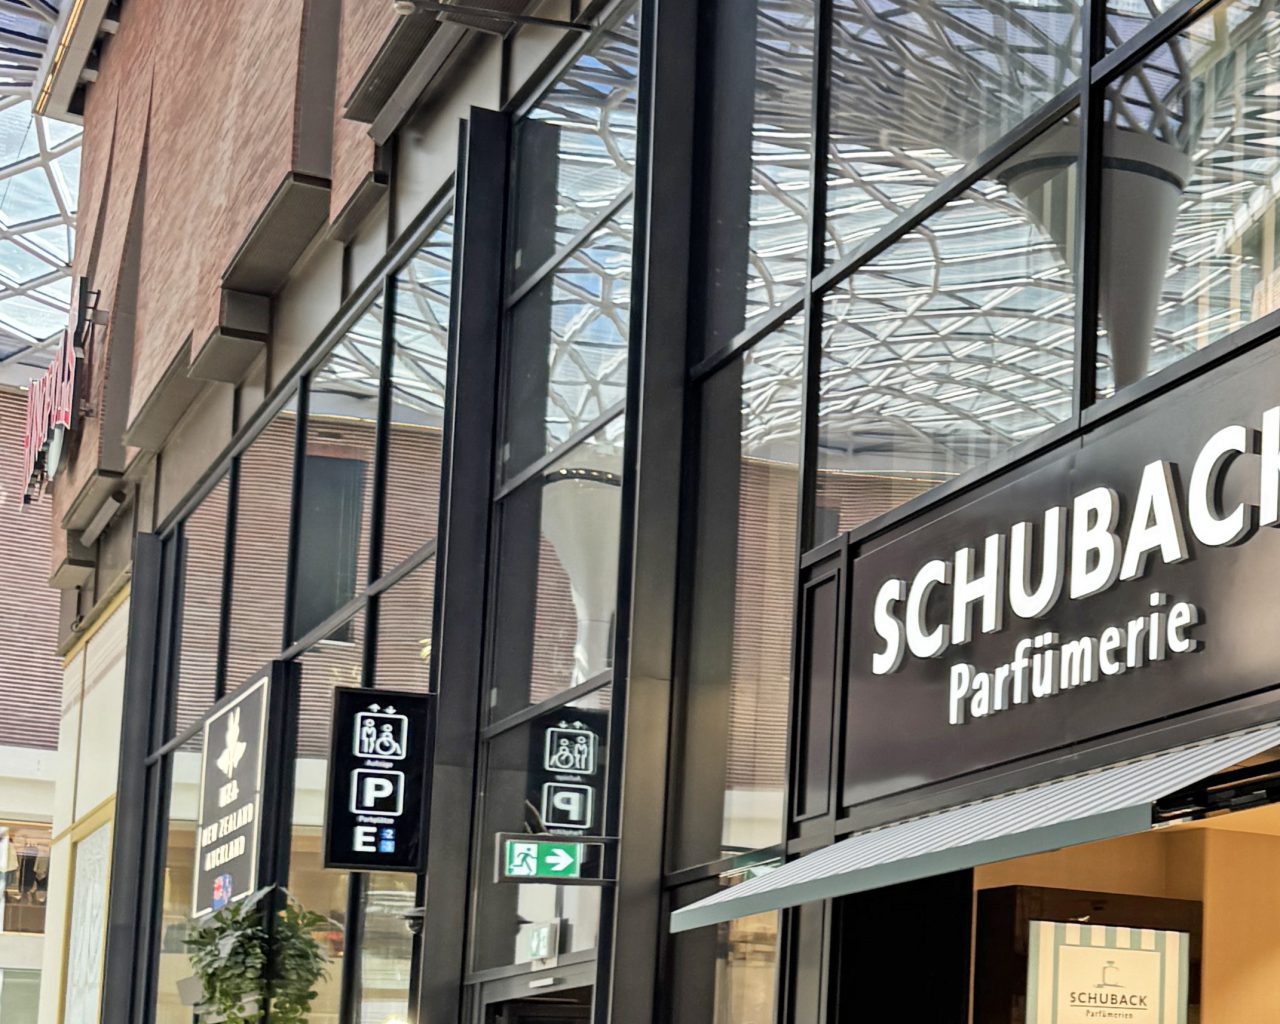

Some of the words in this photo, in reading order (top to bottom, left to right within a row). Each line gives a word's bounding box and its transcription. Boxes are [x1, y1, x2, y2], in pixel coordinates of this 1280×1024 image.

[949, 591, 1200, 725] Parfümerie
[363, 777, 394, 808] P
[353, 825, 378, 853] E
[1069, 991, 1148, 1007] SCHUBACK
